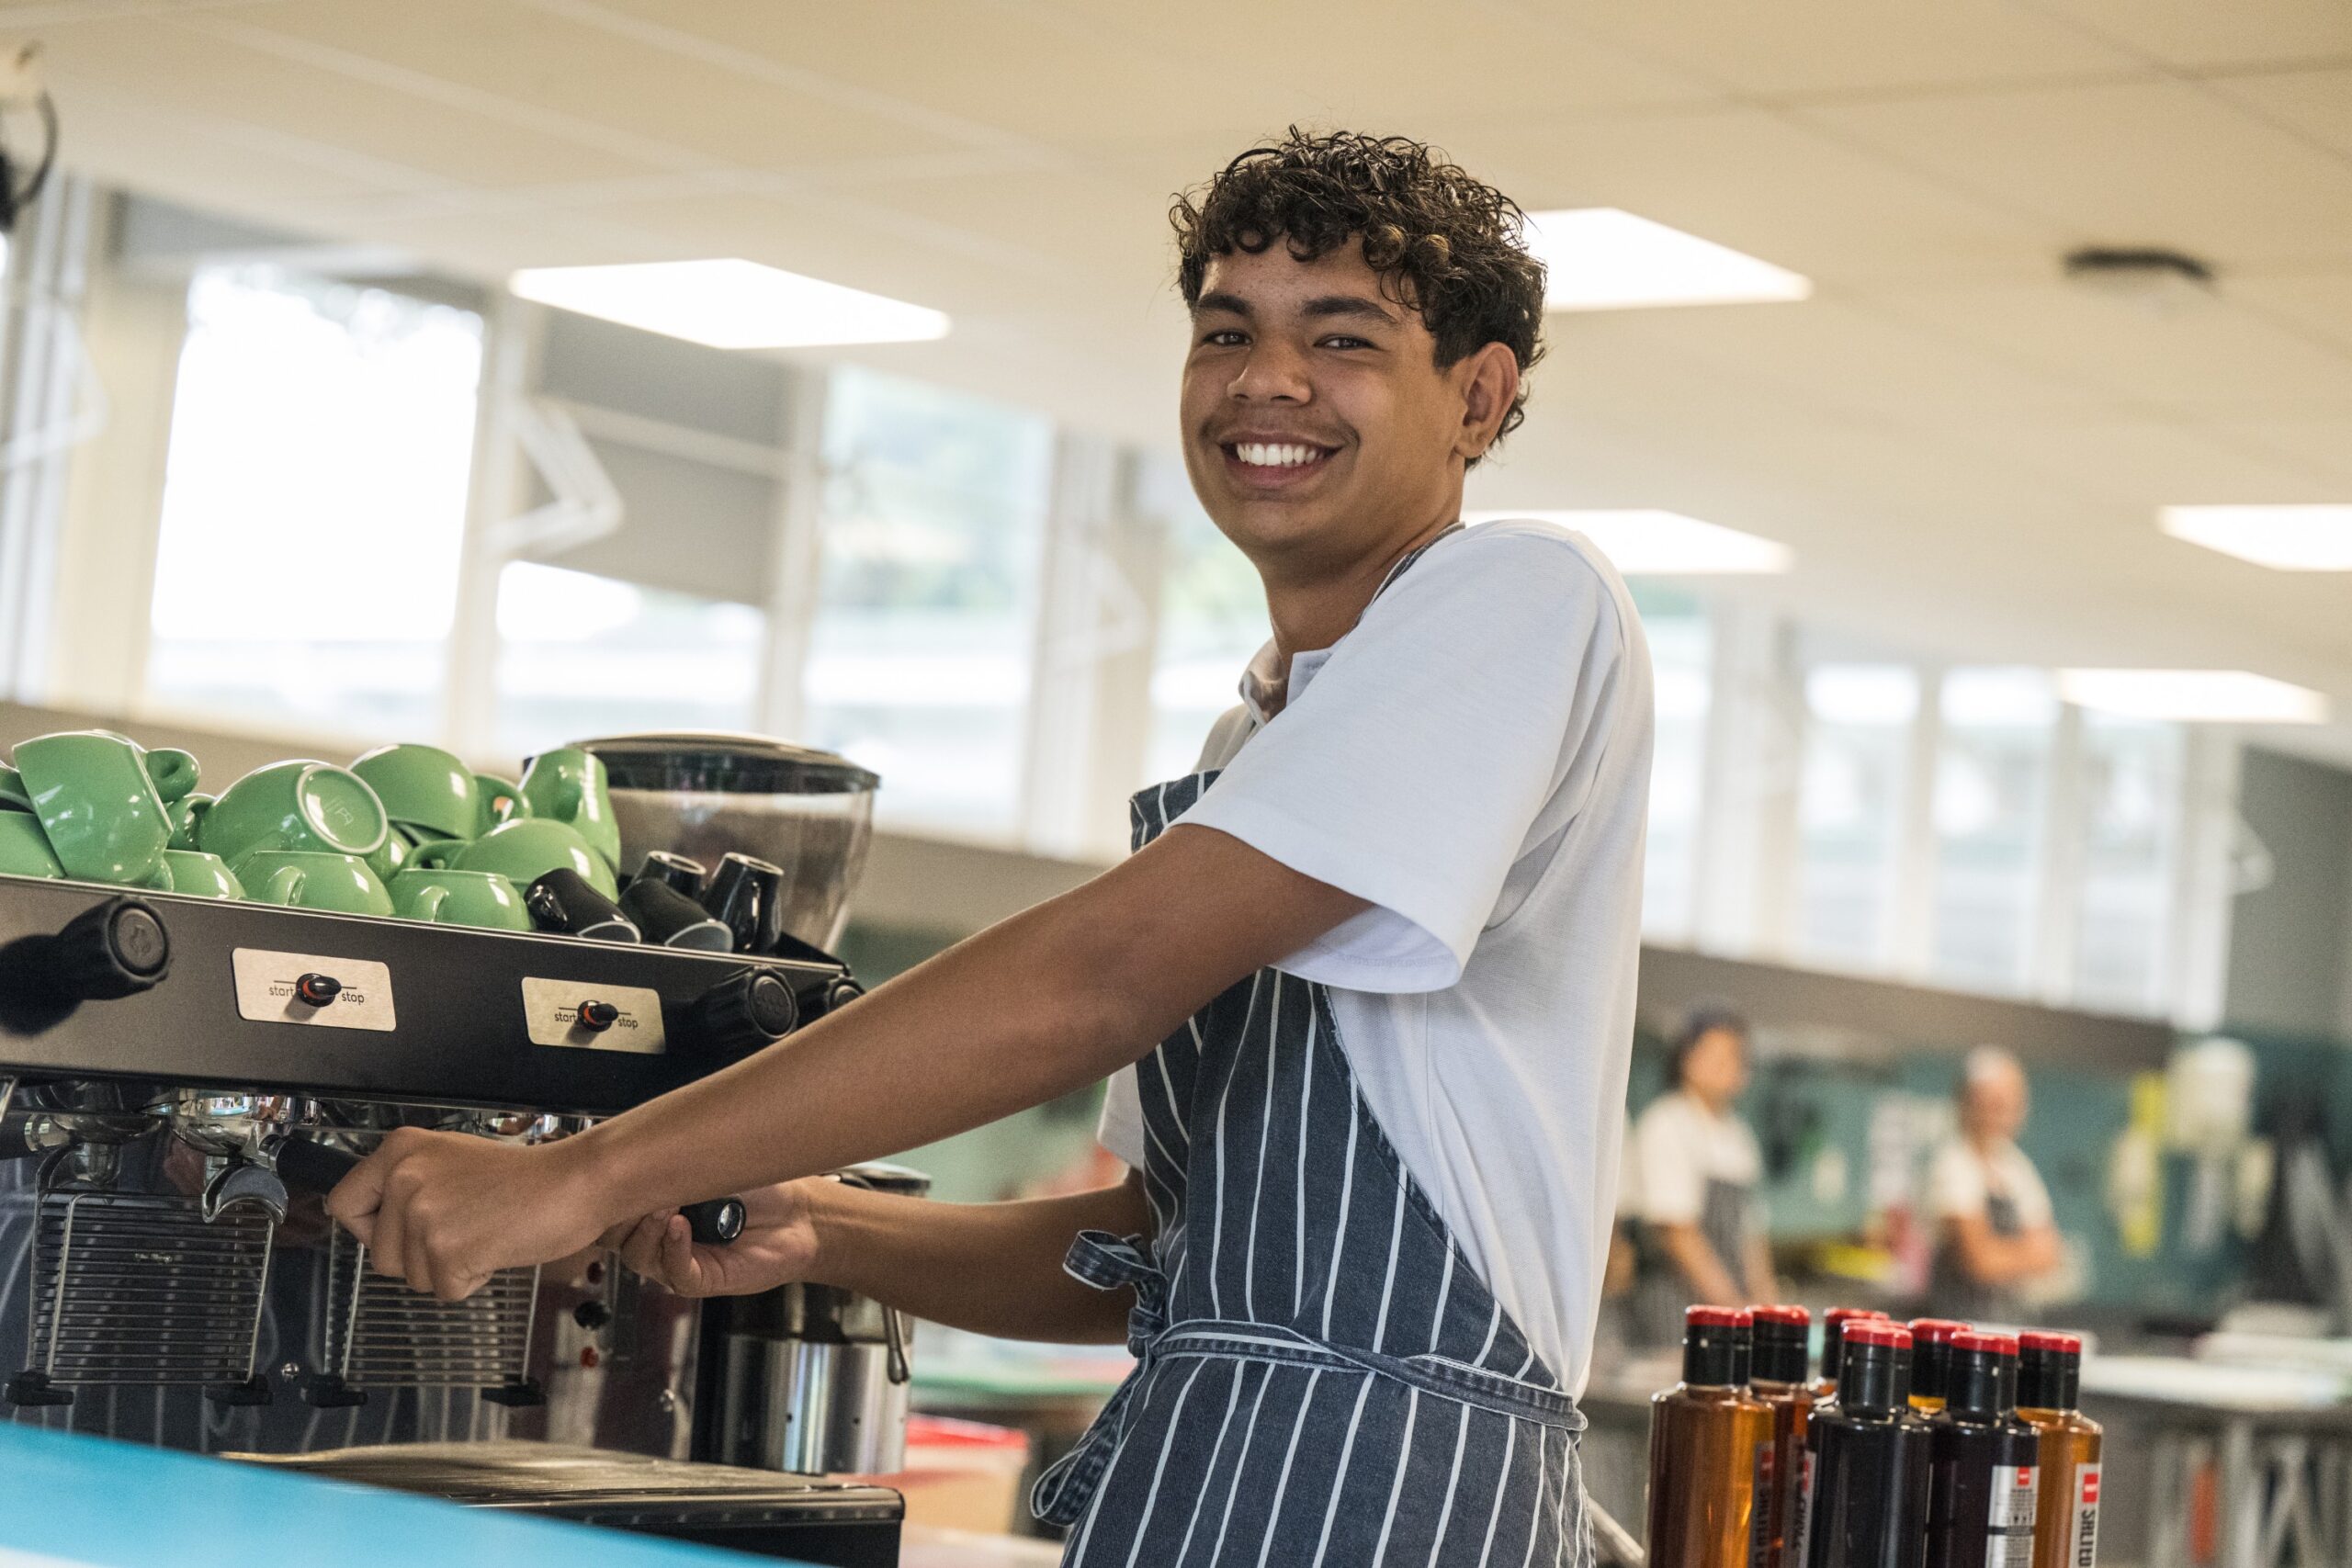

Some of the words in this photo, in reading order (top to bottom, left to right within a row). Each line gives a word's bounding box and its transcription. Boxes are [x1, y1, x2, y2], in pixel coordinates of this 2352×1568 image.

[269, 986, 295, 997] start
[341, 992, 365, 1005] stop
[554, 1012, 577, 1023] start
[617, 1017, 639, 1030] stop
